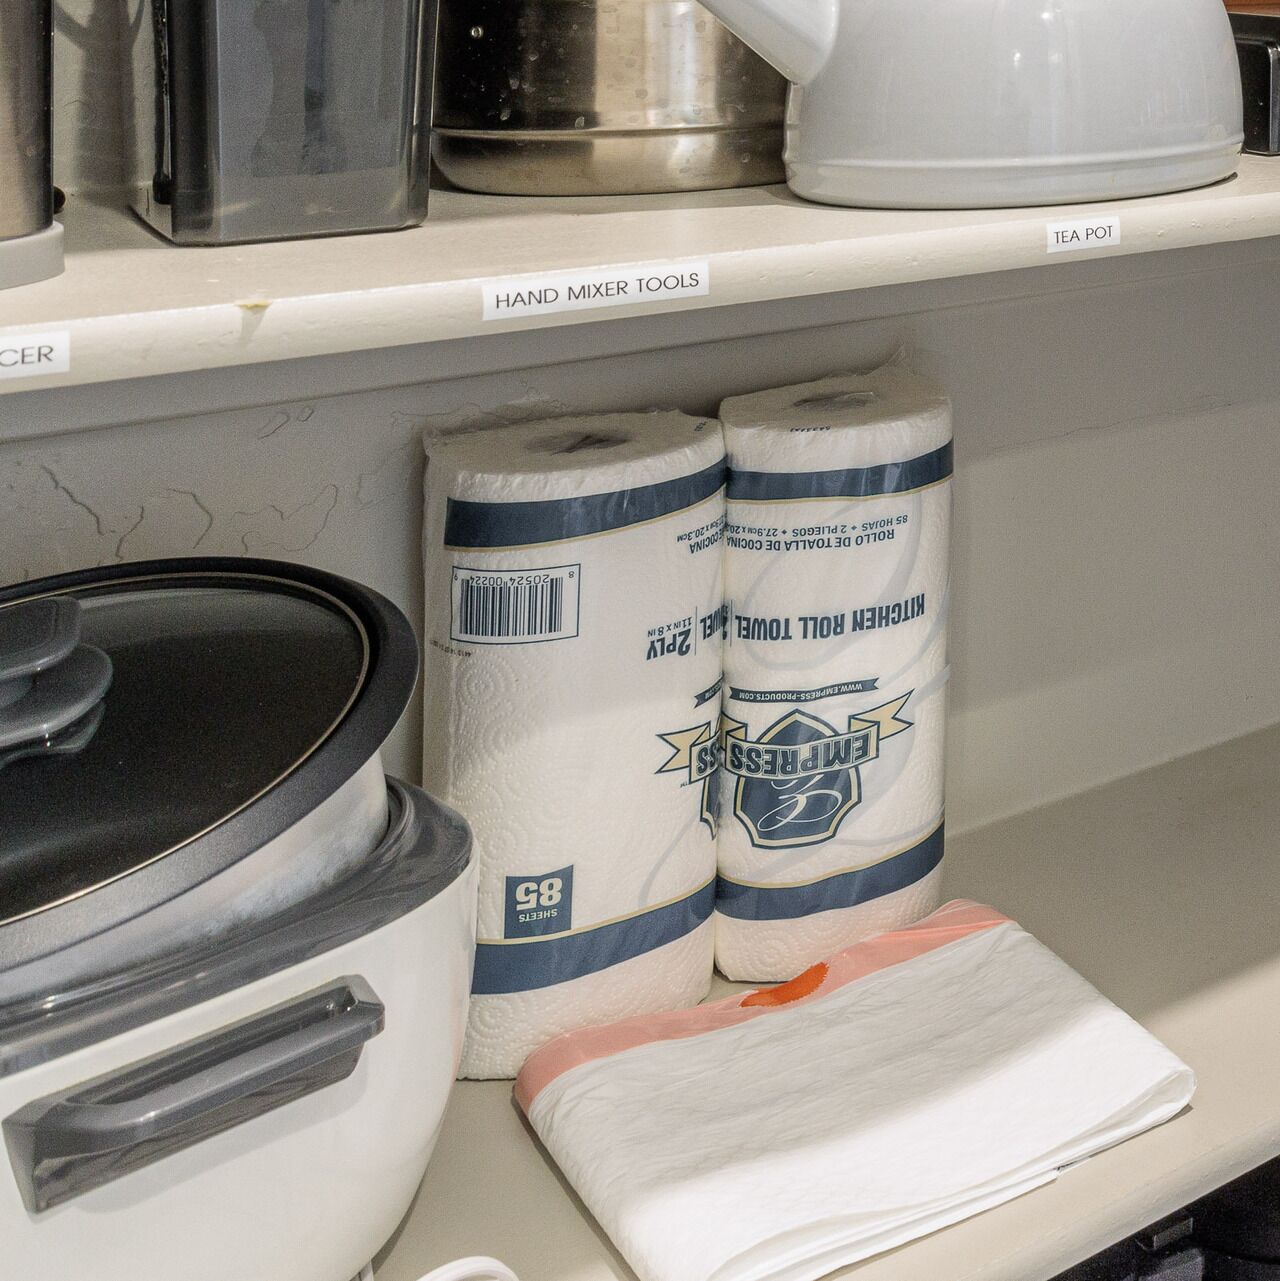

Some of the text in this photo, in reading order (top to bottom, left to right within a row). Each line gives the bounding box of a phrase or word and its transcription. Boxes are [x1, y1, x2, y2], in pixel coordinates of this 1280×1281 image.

[1054, 225, 1113, 244] TEA POT
[496, 272, 699, 309] HAND MIXER TOOLS
[792, 514, 908, 537] 85 HOJAS 2 PLIEGOS
[726, 529, 895, 552] ROLLO DE TOALLA DE COCINA
[470, 575, 503, 586] 00224
[509, 574, 549, 586] 20524
[852, 593, 925, 633] KITCHEN
[734, 615, 793, 641] TOWEL
[802, 615, 845, 640] ROLL
[646, 628, 692, 661] 2PLY
[739, 683, 863, 701] WWW.EMPRESS-PRODUCTS.COM
[730, 732, 871, 775] EMPRESS
[515, 877, 563, 911] 85
[518, 908, 558, 923] SHEETS
